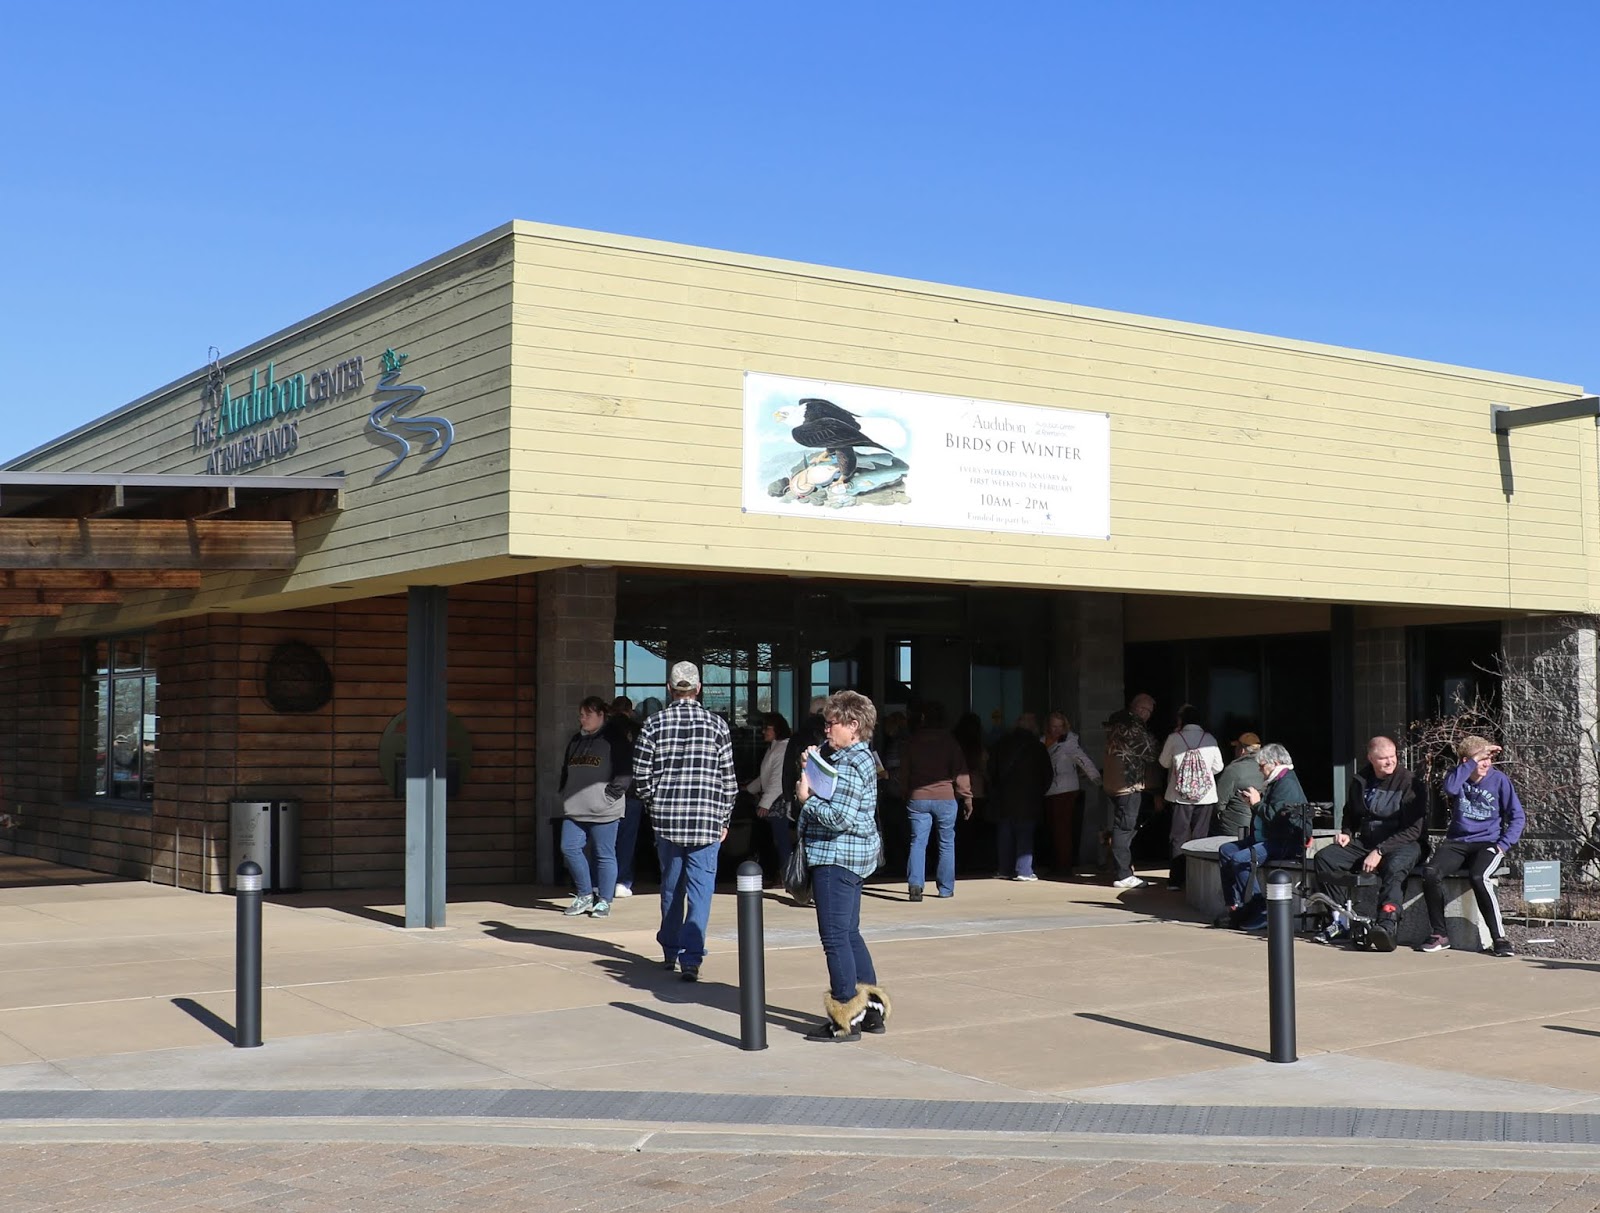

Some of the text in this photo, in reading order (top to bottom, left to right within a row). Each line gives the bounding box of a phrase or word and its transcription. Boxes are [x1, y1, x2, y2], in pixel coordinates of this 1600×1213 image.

[194, 355, 366, 447] THE Audubon CENTER
[972, 414, 1027, 434] Audubon
[224, 419, 300, 471] RIVERLANDS
[945, 432, 1082, 461] BIRDS OF WINTER
[959, 465, 981, 475] EVERY
[983, 467, 1018, 478] WEEKEND
[1030, 471, 1060, 482] JANUARY
[969, 477, 989, 486] FIRST
[991, 478, 1026, 489] WEEKEND
[1039, 482, 1073, 493] FEBRUARY
[980, 493, 1012, 508] 10AM
[1024, 497, 1049, 511] 2PM
[967, 511, 994, 522] Funded
